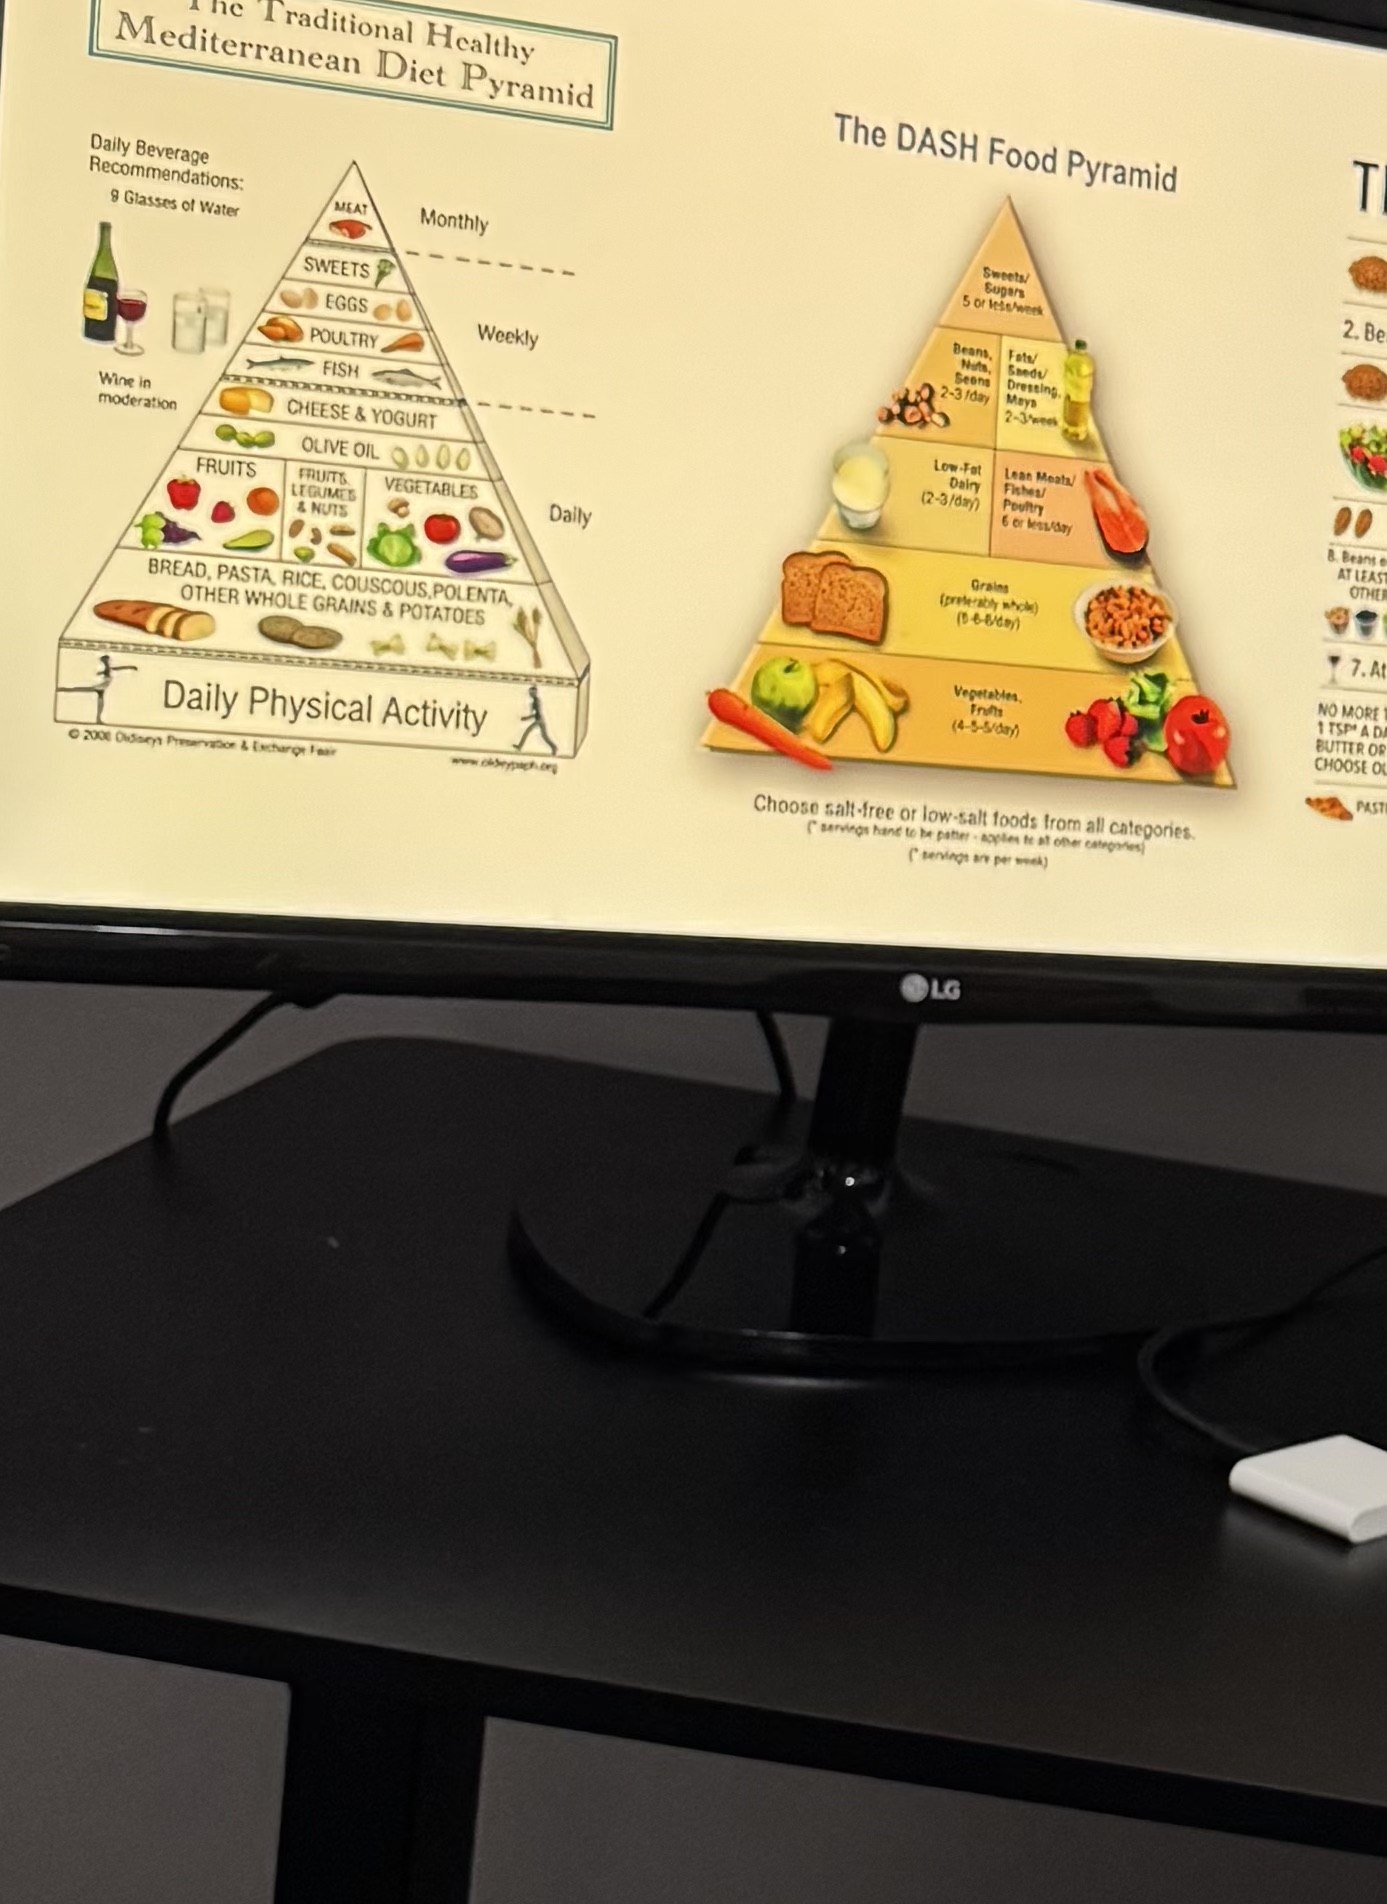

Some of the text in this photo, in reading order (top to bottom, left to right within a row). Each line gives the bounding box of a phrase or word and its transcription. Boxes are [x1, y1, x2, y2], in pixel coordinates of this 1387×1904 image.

[427, 21, 535, 65] Healthy
[115, 10, 594, 109] Mediterranean Diet Pyramid
[91, 133, 210, 166] Daily Beverage
[834, 113, 1178, 193] The DASH Food Pyramid
[89, 156, 244, 191] Recommendations:
[124, 191, 177, 210] Glasses
[182, 199, 194, 212] of
[200, 201, 240, 217] Water
[334, 201, 367, 216] MEAT
[420, 207, 489, 236] Monthly
[304, 256, 370, 278] SWEETS
[326, 293, 368, 313] EGGS
[310, 327, 379, 348] POULTRY
[478, 323, 539, 351] Weekly
[1343, 319, 1359, 340] 2.
[99, 371, 151, 389] Wine in
[323, 361, 359, 379] FISH
[98, 393, 177, 410] moderation
[288, 399, 437, 430] CHEESE & YOGURT
[301, 436, 380, 460] OLIVE OIL
[196, 457, 257, 479] FRUITS
[385, 476, 479, 499] VEGETABLES
[549, 504, 592, 529] Daily
[149, 558, 211, 580] BREAD,
[181, 585, 485, 626] OTHER WHOLE GRAINS & POTATOES
[1352, 658, 1366, 677] 7.
[1370, 660, 1386, 680] At
[164, 680, 488, 737] Daily Physical Activity
[1318, 703, 1338, 717] NO
[1342, 705, 1380, 721] MORE
[1314, 757, 1367, 774] CHOOSE
[754, 794, 819, 815] Choose
[825, 800, 894, 820] salt-free
[900, 806, 916, 821] or
[923, 805, 987, 826] low-salt
[993, 810, 1038, 829] foods
[1044, 814, 1081, 831] from
[1086, 817, 1105, 834] all
[1110, 819, 1196, 841] categories.
[931, 978, 960, 1000] LG
